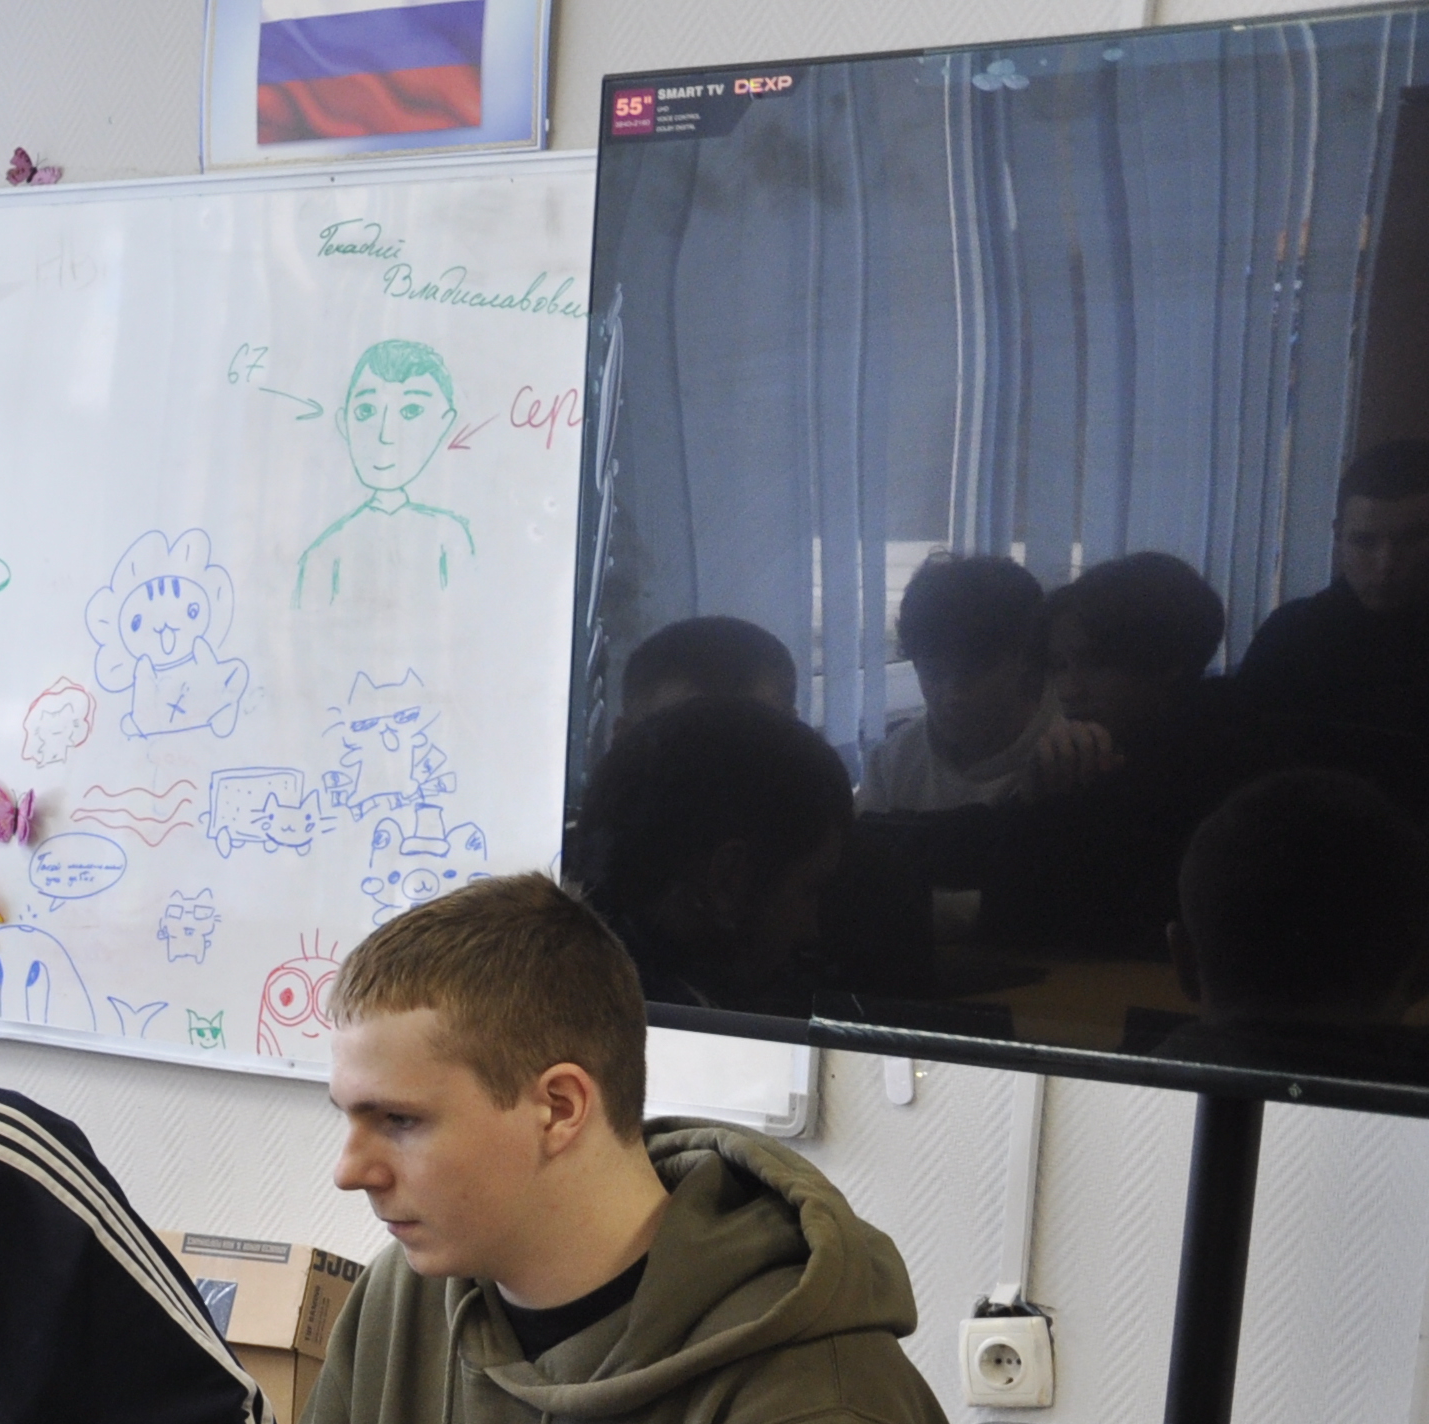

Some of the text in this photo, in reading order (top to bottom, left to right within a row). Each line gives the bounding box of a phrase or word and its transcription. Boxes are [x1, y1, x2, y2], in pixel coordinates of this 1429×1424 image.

[657, 84, 725, 100] SMART TV
[734, 75, 793, 95] DEXP
[382, 263, 590, 319] Владиславови
[227, 343, 269, 384] 67
